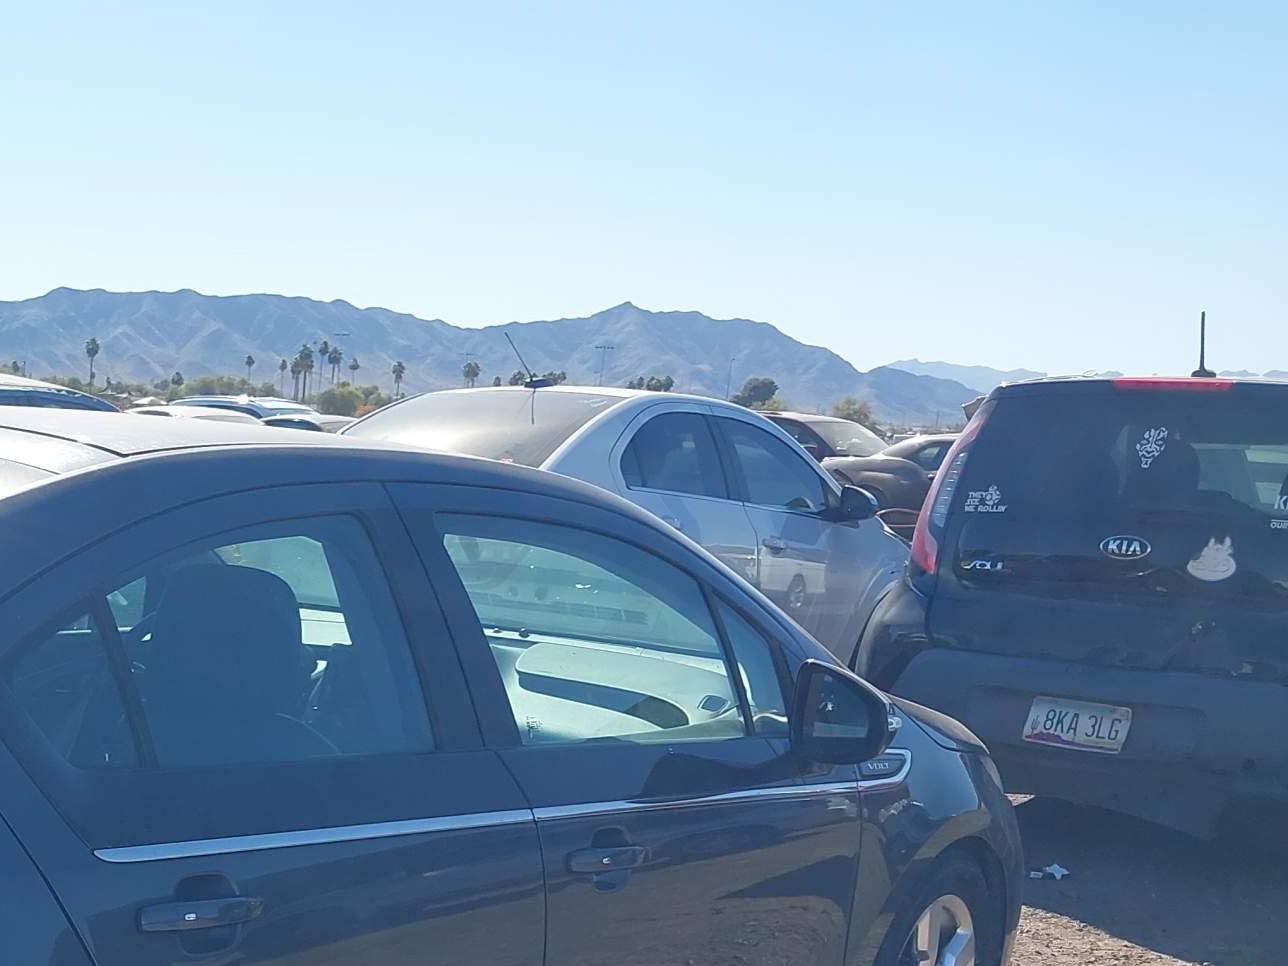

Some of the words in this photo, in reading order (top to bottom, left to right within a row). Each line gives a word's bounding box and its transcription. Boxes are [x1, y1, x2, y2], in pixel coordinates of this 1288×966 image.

[1107, 540, 1141, 555] KIA
[1043, 708, 1080, 737] 8KA
[1085, 715, 1123, 741] 3LG
